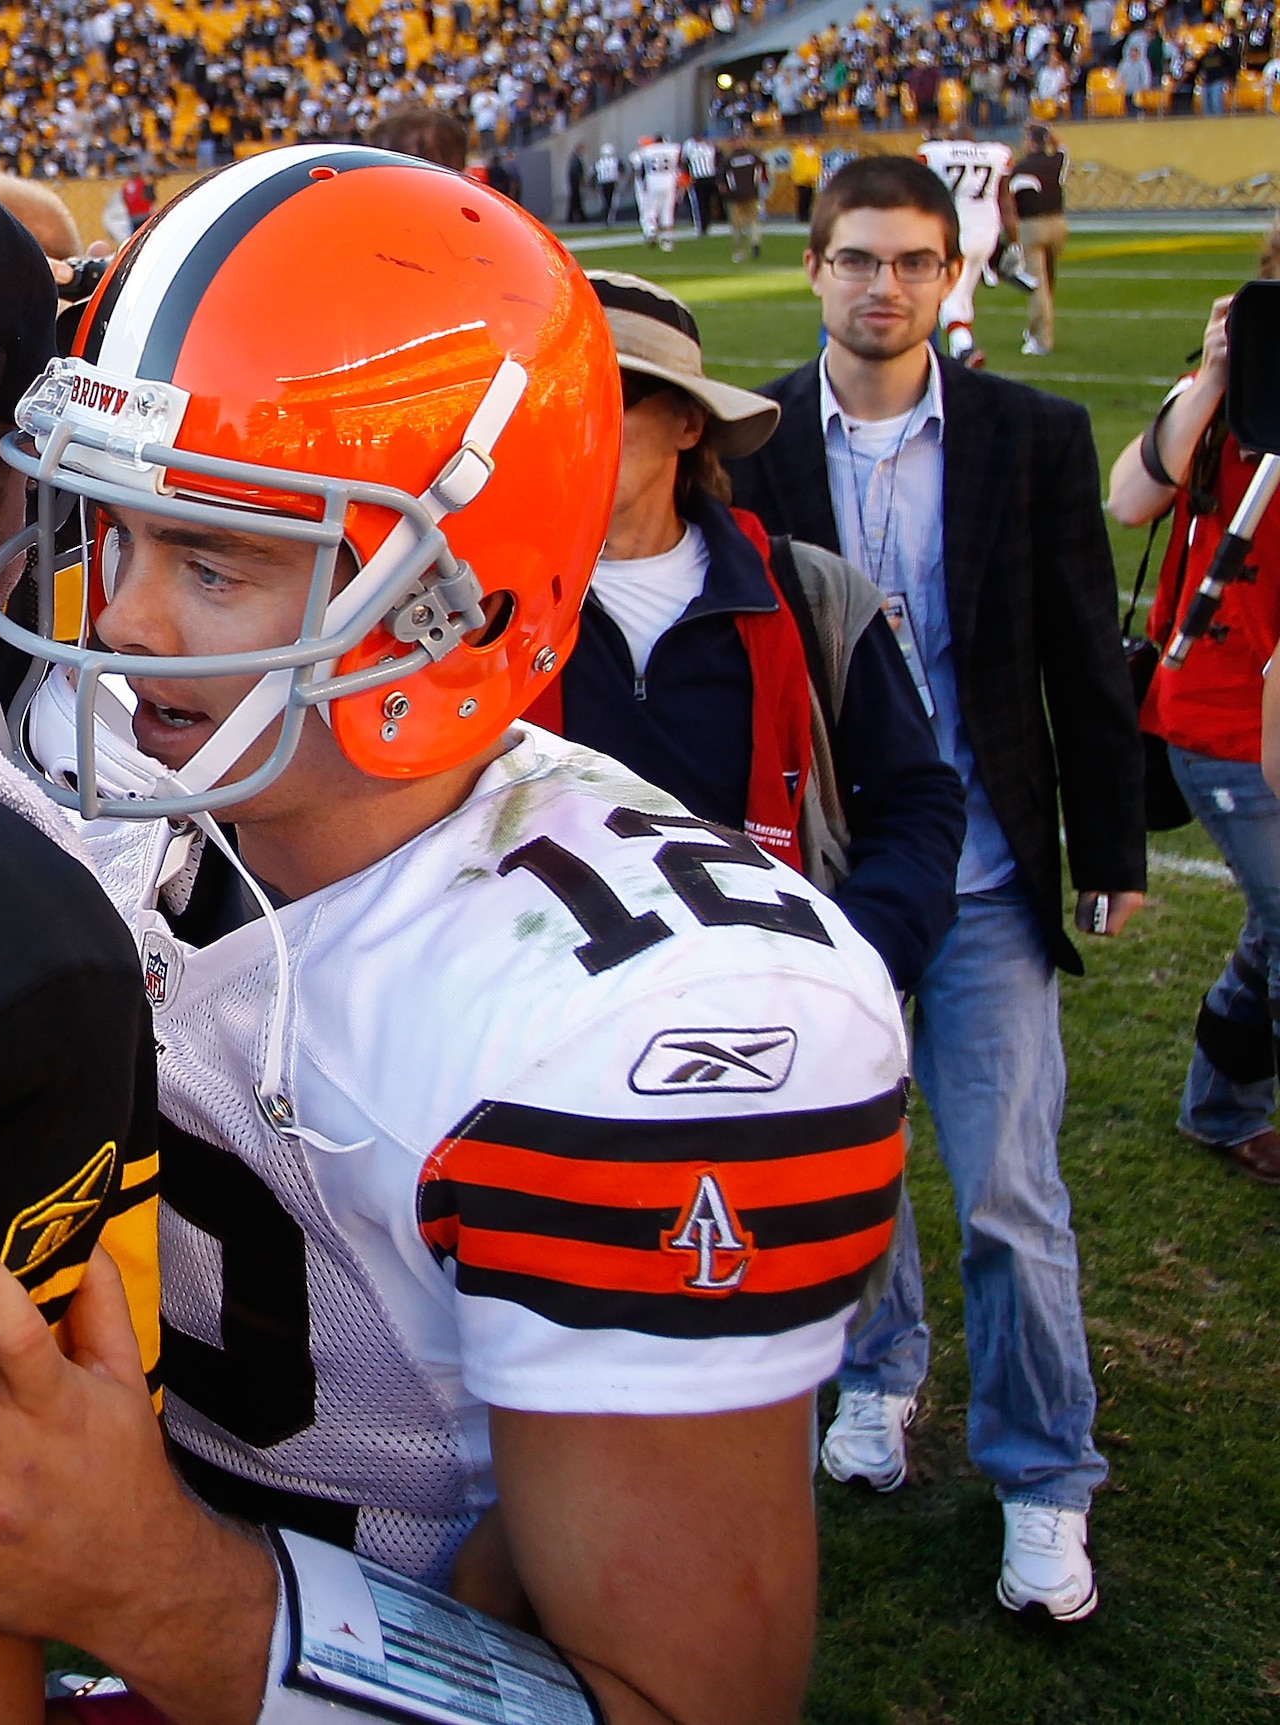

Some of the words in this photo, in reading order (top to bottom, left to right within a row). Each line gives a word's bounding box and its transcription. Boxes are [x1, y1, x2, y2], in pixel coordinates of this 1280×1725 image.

[946, 164, 991, 199] 77
[496, 806, 838, 977] 12
[145, 973, 165, 1001] NFL
